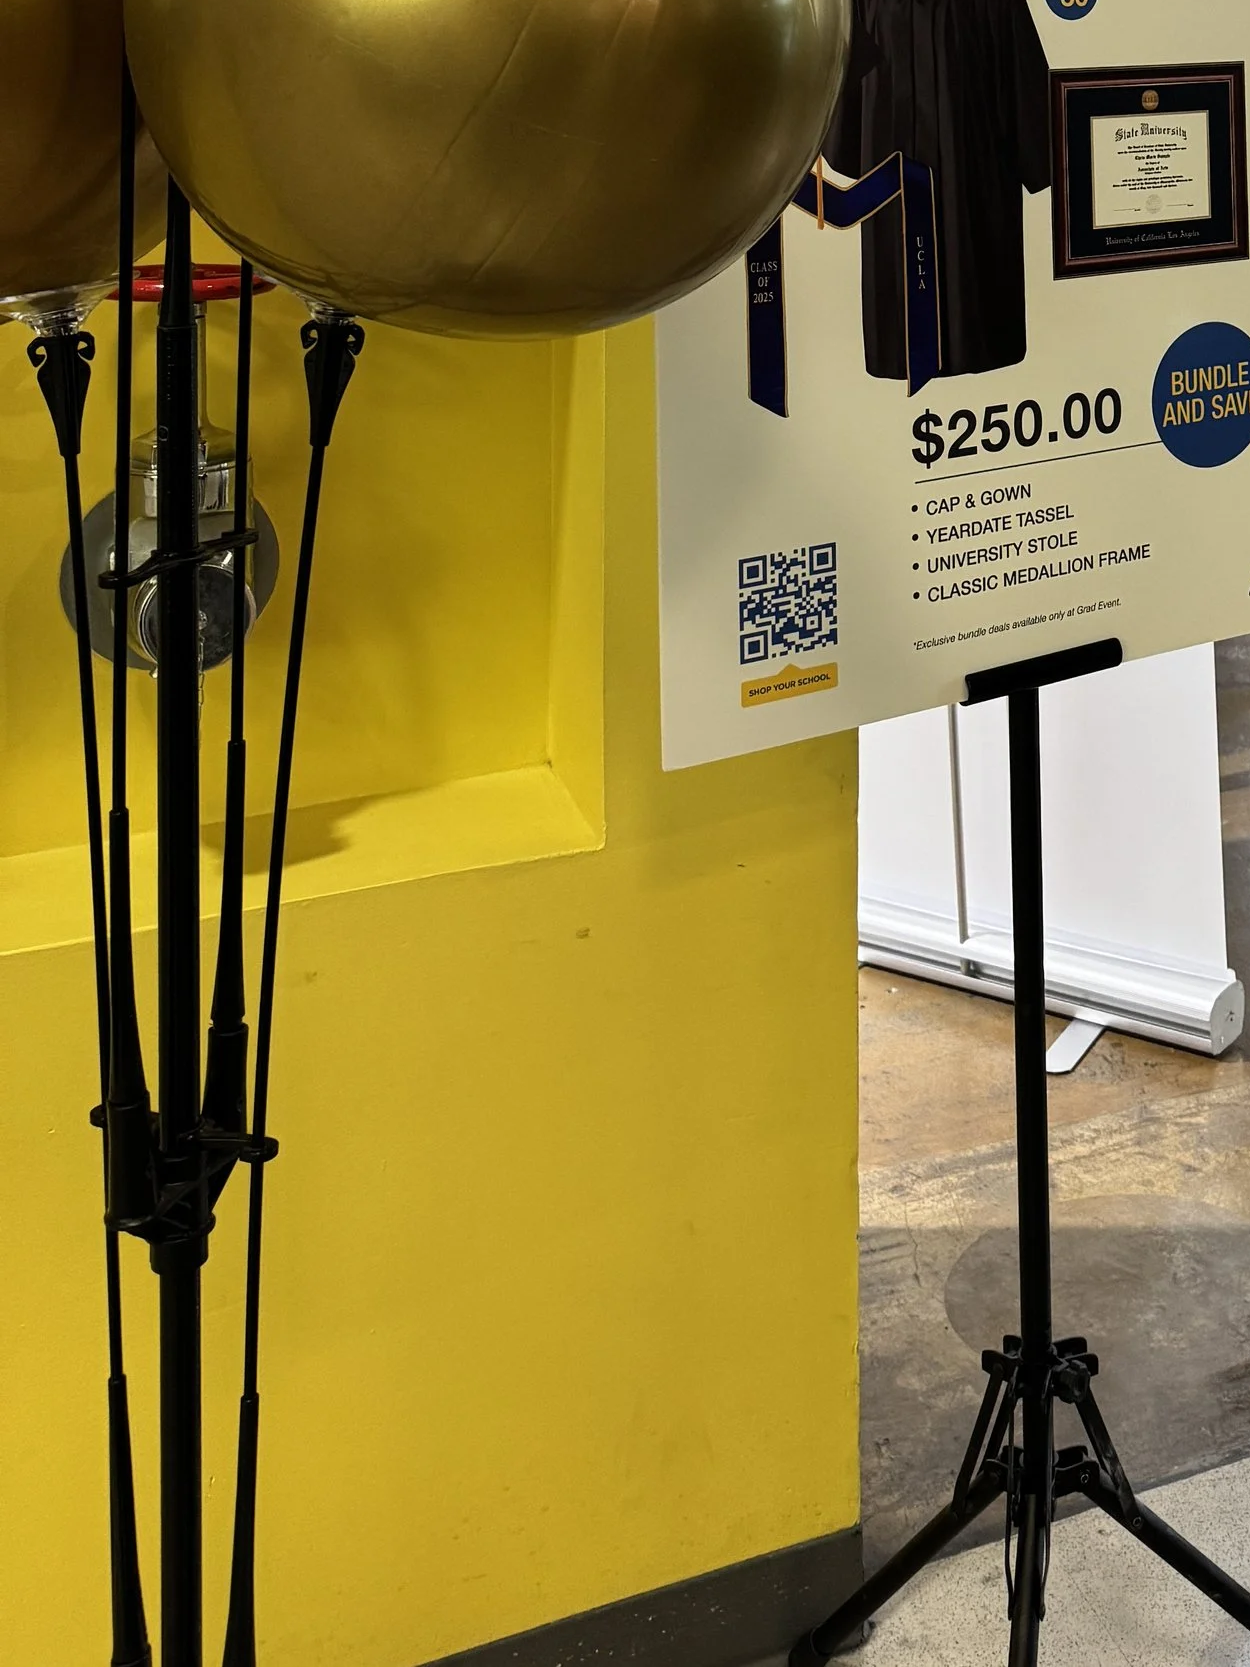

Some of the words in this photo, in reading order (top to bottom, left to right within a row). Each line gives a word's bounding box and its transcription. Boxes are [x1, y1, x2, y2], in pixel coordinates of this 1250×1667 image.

[750, 261, 778, 273] CLASS
[916, 236, 927, 290] UCLA
[753, 291, 774, 303] 2025
[757, 276, 771, 287] OF
[1171, 361, 1249, 396] BUNDLE
[912, 388, 1121, 469] $250.00
[1163, 398, 1204, 427] AND
[926, 496, 960, 516] CAP
[965, 493, 976, 509] &
[981, 483, 1031, 506] GOWN
[926, 515, 1012, 544] YEARDATE
[1016, 505, 1074, 527] TASSEL
[928, 541, 1023, 573] UNIVERSITY
[1028, 531, 1078, 554] STOLE
[928, 575, 998, 602] CLASSIC
[1003, 555, 1094, 587] MEDALLION
[1099, 544, 1150, 567] FRAME
[957, 628, 987, 642] bundle
[988, 621, 1010, 635] deals
[1012, 614, 1047, 630] available
[1048, 611, 1065, 622] only
[1067, 608, 1075, 617] at
[1076, 603, 1096, 615] Grad
[1097, 598, 1121, 610] Event.
[748, 685, 772, 697] SHOP
[773, 680, 796, 691] YOUR
[797, 673, 831, 686] SCHOOL
